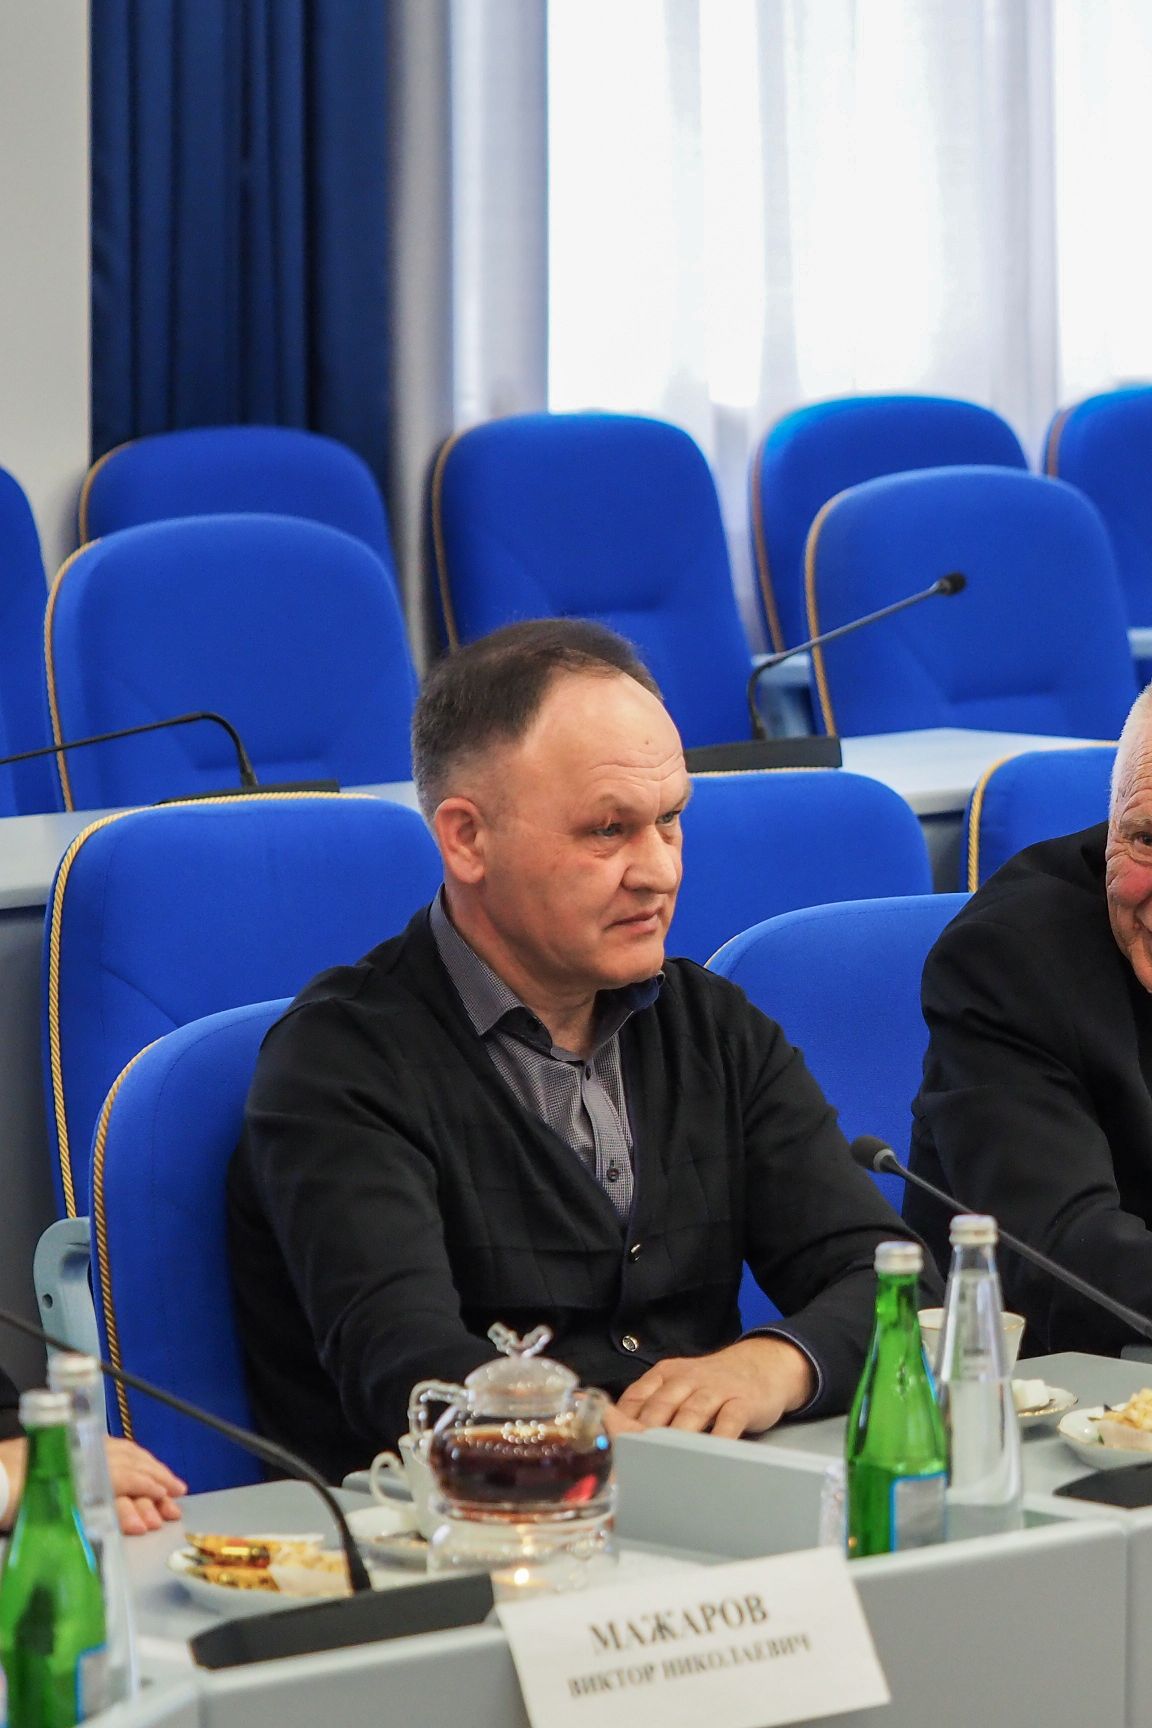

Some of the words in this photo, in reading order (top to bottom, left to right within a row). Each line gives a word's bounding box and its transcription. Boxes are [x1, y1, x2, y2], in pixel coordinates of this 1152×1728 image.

[589, 1594, 769, 1655] МАЖАРОВ
[568, 1665, 655, 1697] ВИКТОР
[662, 1633, 812, 1680] НИКОЛАЕВИЧ
